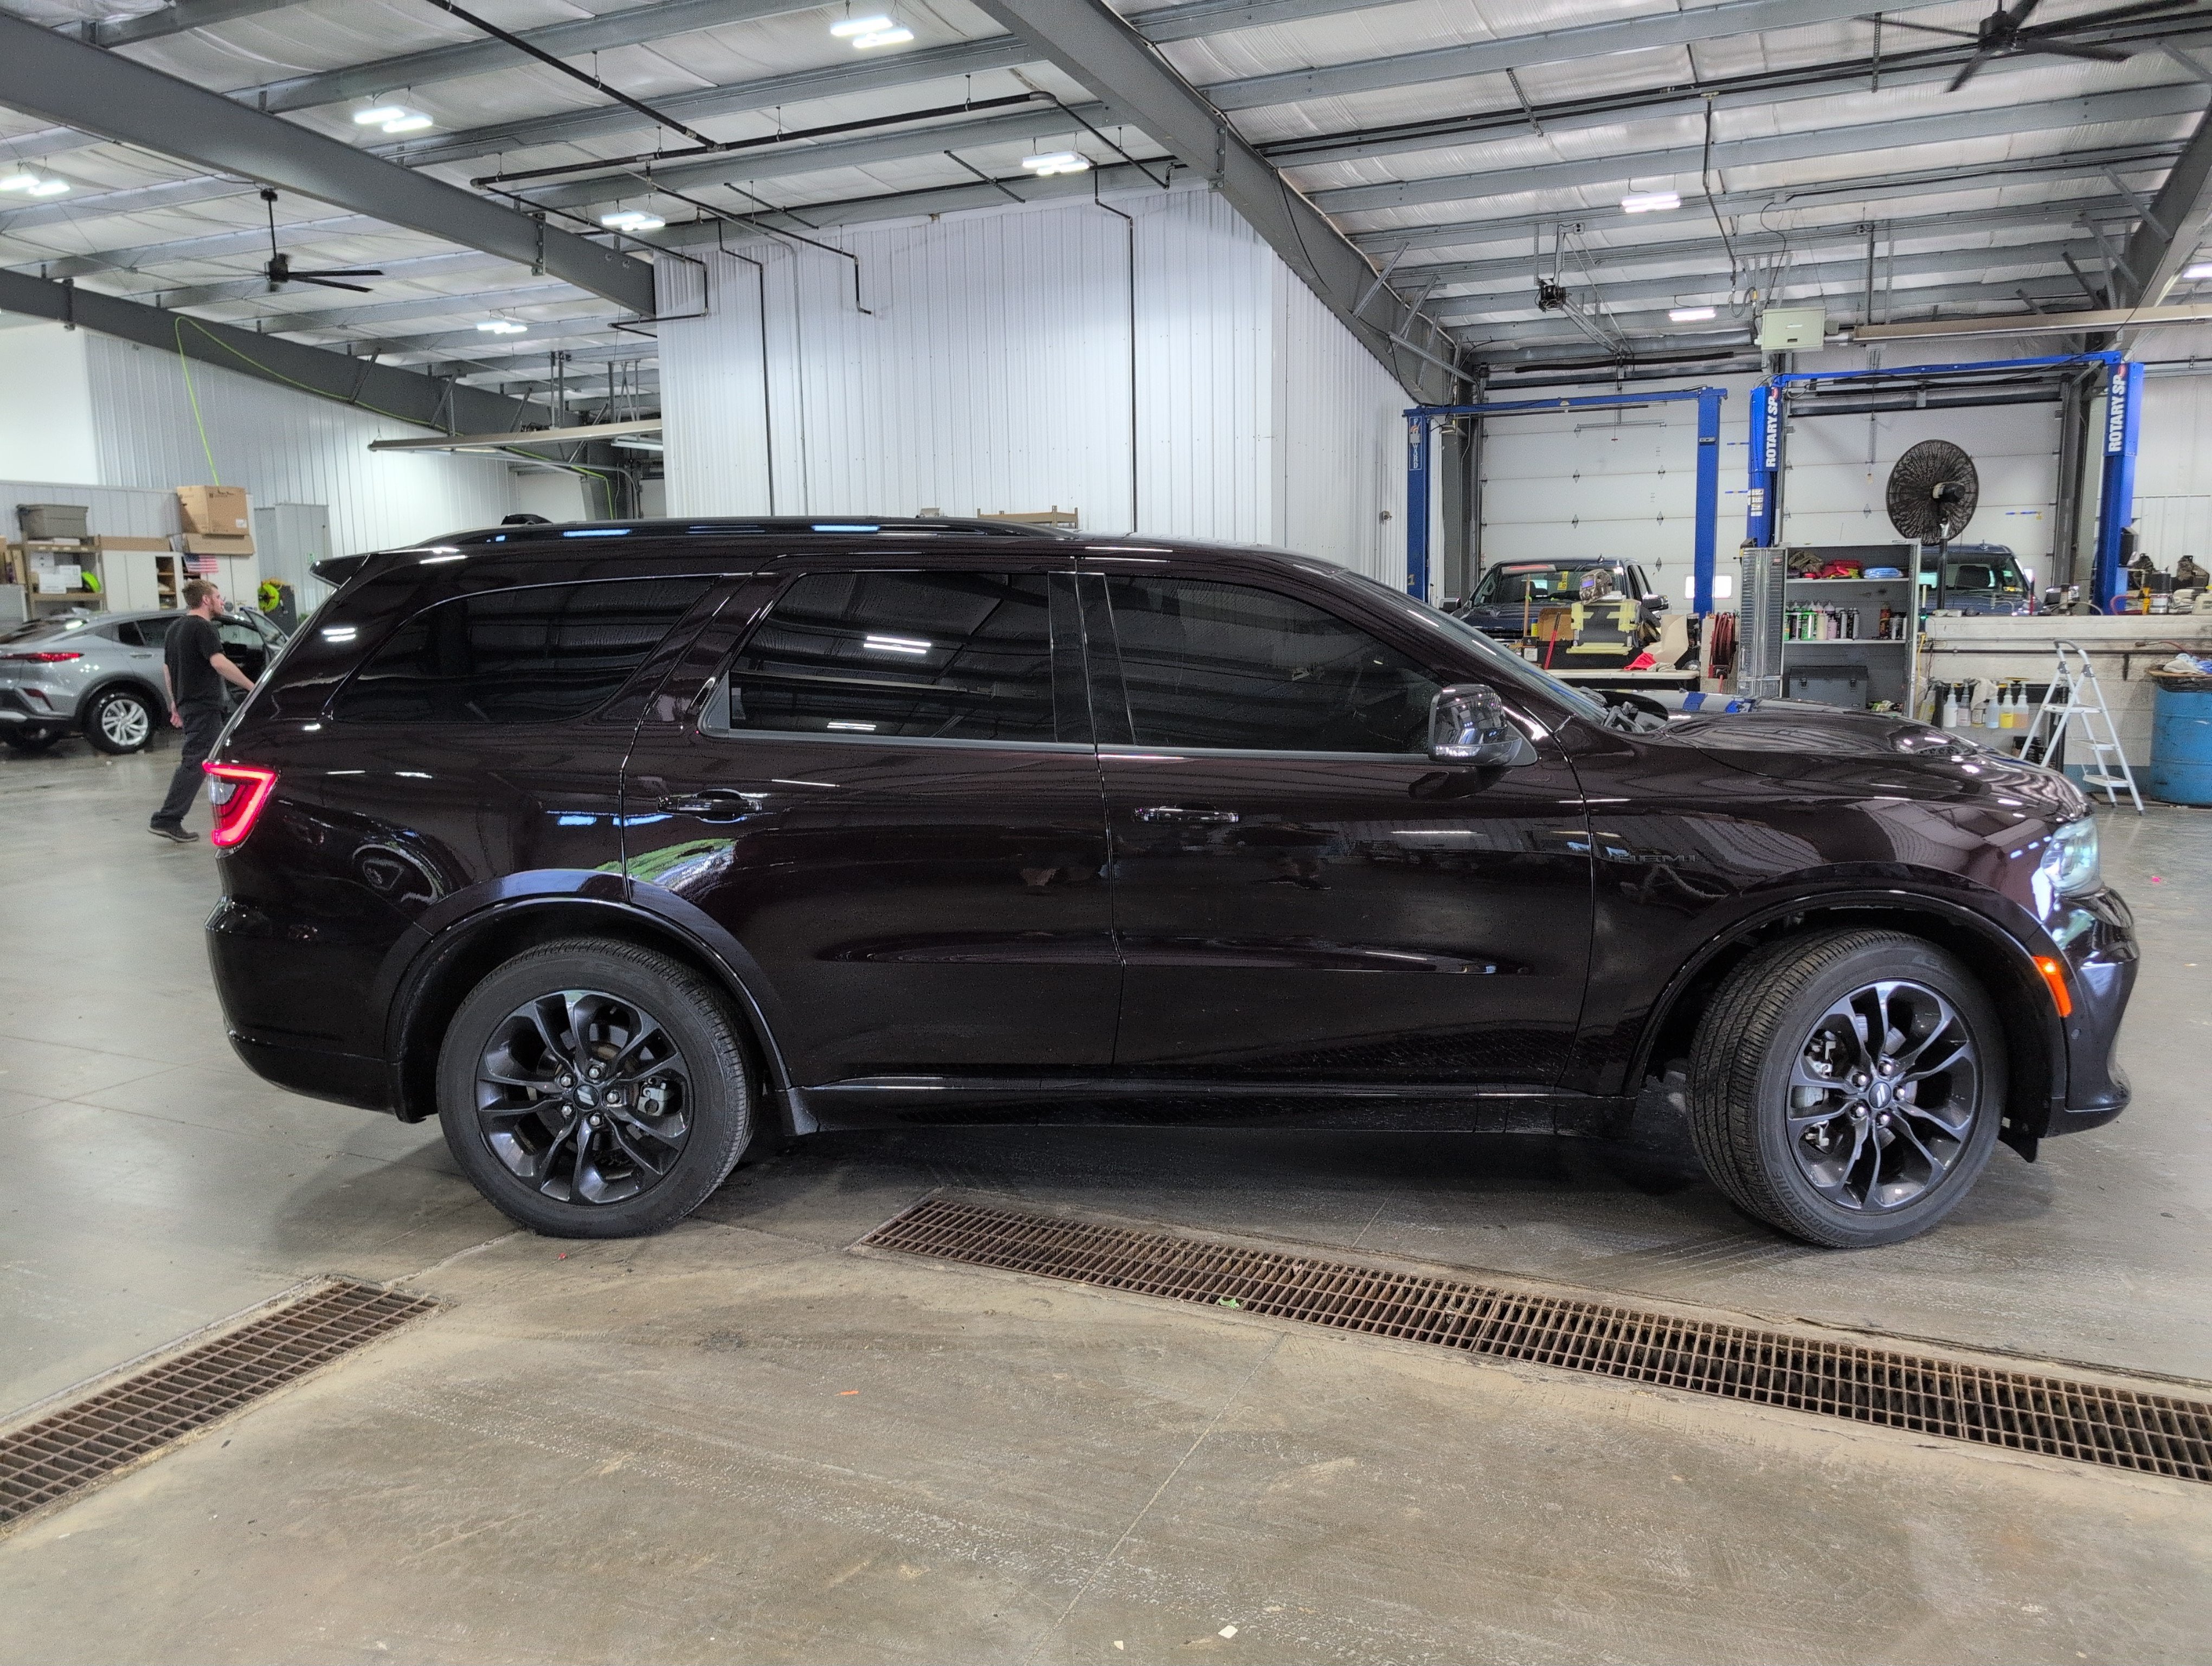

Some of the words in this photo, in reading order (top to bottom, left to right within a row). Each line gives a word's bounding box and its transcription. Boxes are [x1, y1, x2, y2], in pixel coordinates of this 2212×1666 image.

[1411, 418, 1420, 469] FWARD
[1766, 415, 1777, 467] ROTARY
[2108, 396, 2125, 452] ROTARY
[1617, 854, 1696, 863] HEMI
